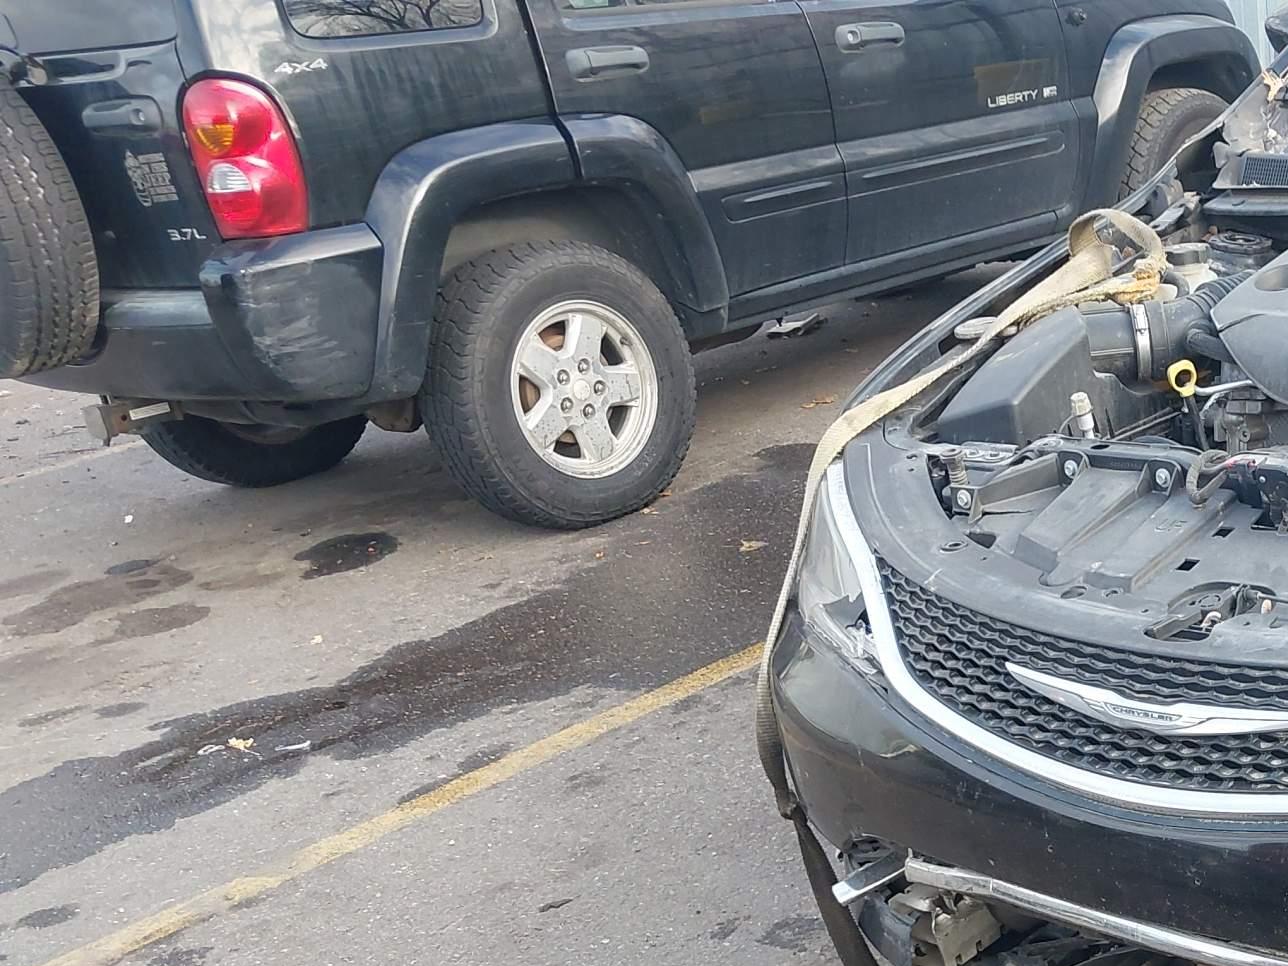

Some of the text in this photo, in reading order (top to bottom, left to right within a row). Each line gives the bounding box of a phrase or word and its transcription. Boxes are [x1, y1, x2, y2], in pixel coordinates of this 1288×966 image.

[987, 88, 1039, 108] LIBERTY
[167, 227, 207, 241] 3.7L
[1112, 705, 1174, 722] CHRYSLER
